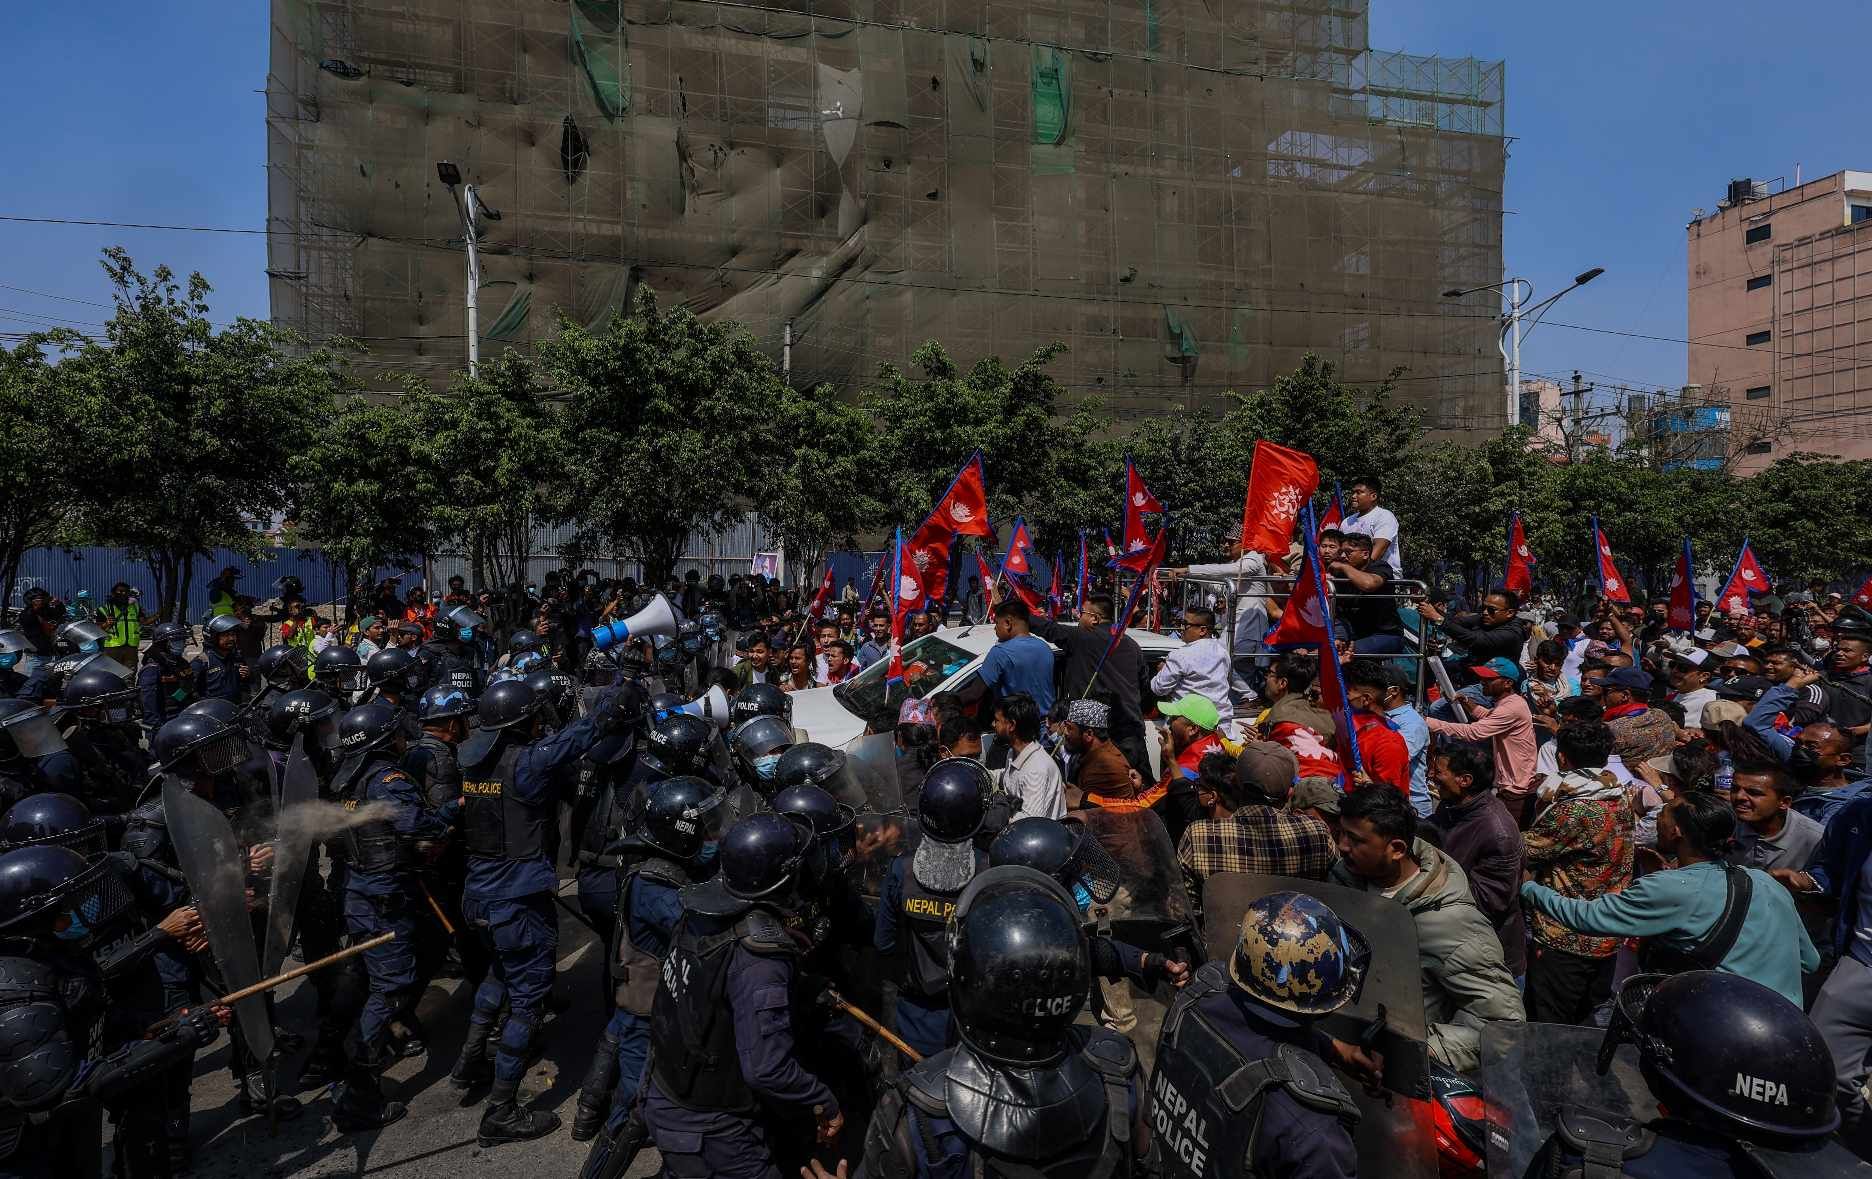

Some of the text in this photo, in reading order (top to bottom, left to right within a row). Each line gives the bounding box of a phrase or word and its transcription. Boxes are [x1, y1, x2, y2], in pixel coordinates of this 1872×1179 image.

[737, 702, 759, 712] POLICE
[674, 819, 696, 836] NEPAL
[905, 898, 942, 916] NEPAL
[1155, 1069, 1209, 1150] NEPAL
[1151, 1097, 1207, 1179] POLICE
